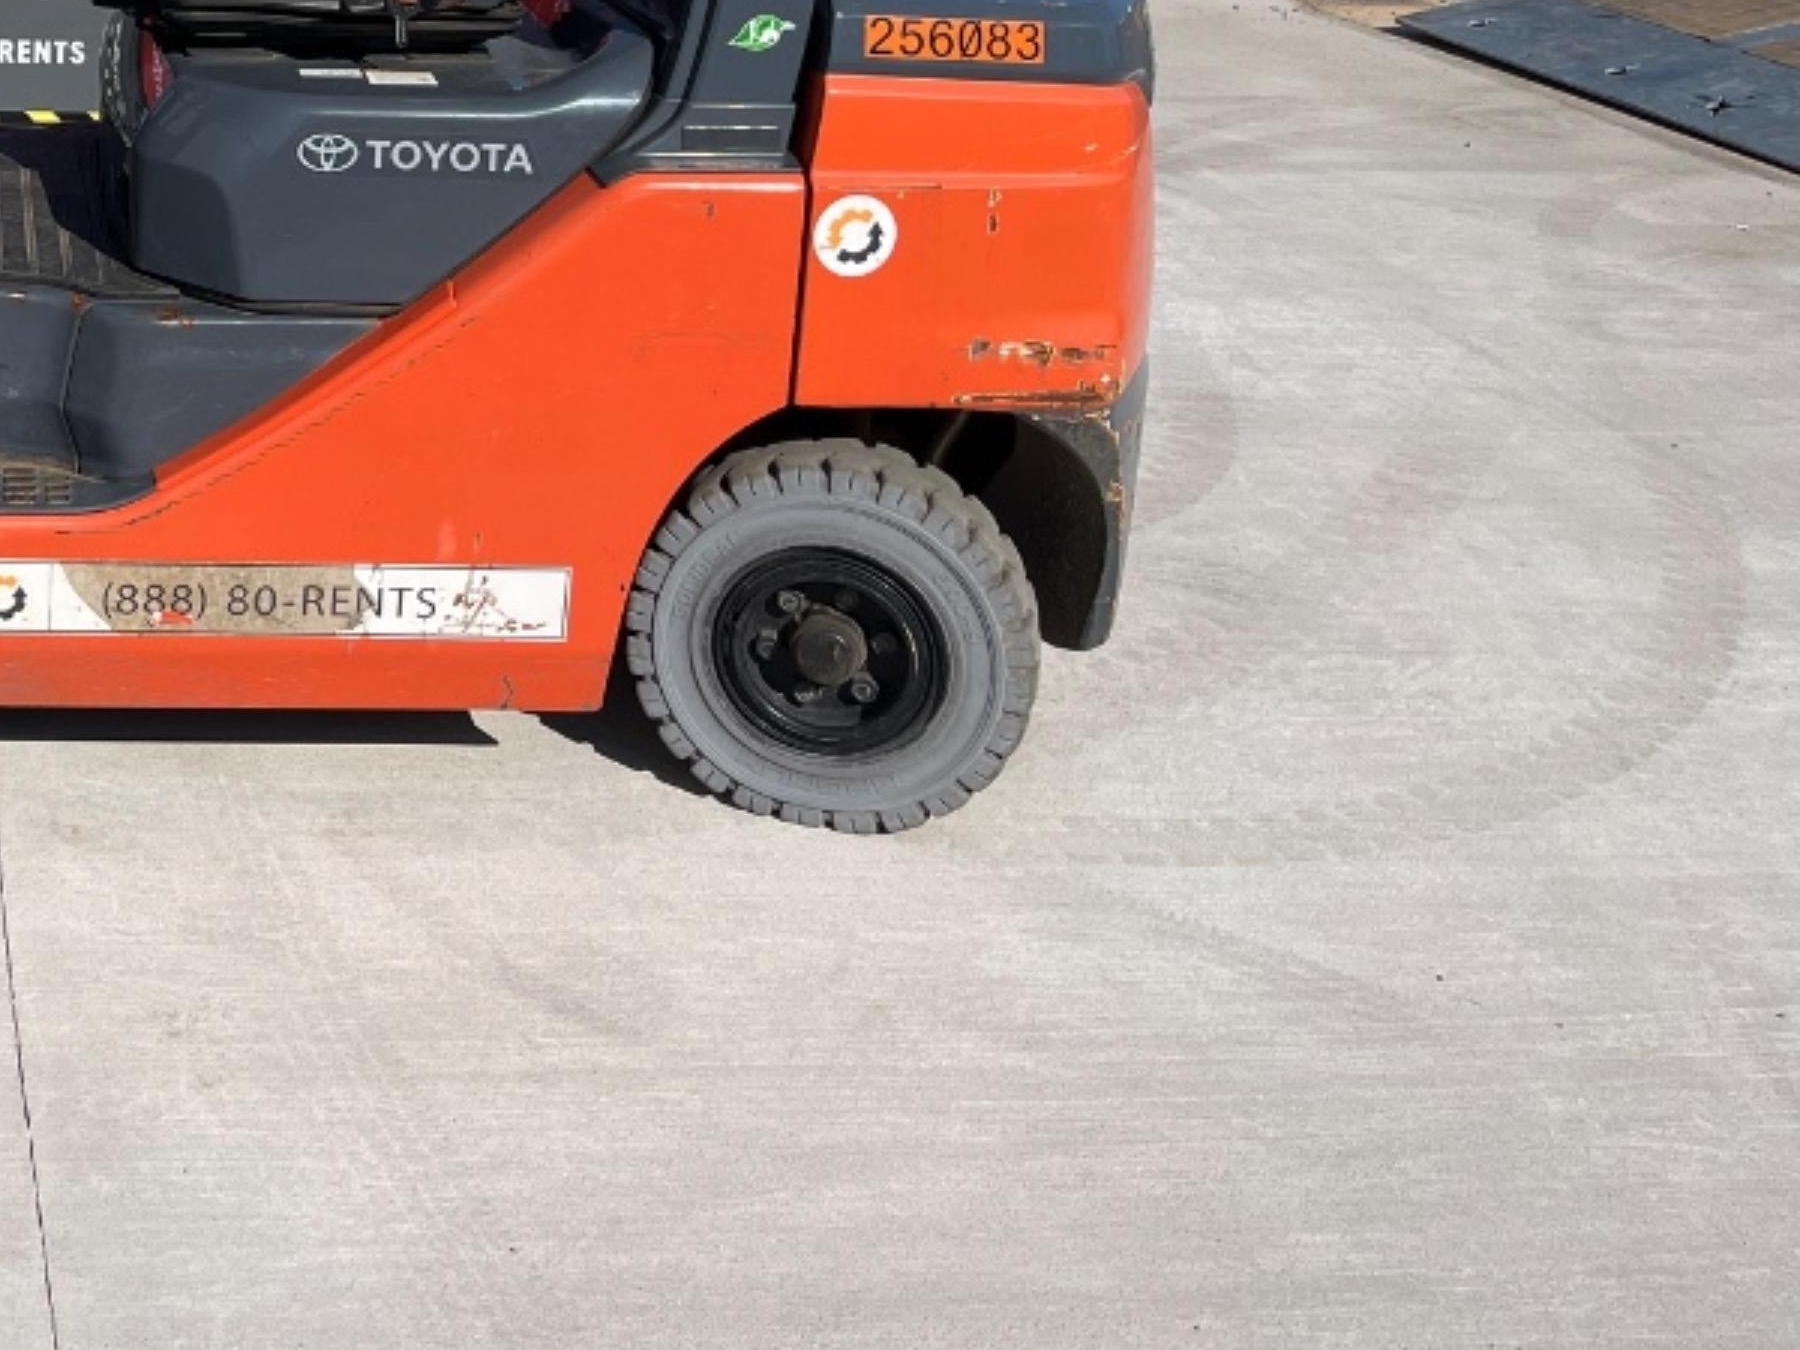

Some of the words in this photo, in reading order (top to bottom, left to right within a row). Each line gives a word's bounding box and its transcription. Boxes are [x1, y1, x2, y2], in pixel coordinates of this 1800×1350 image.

[869, 16, 1039, 61] 256083
[365, 139, 534, 175] TOYOTA
[102, 583, 208, 619] (888)
[227, 584, 437, 620] 80-RENTS
